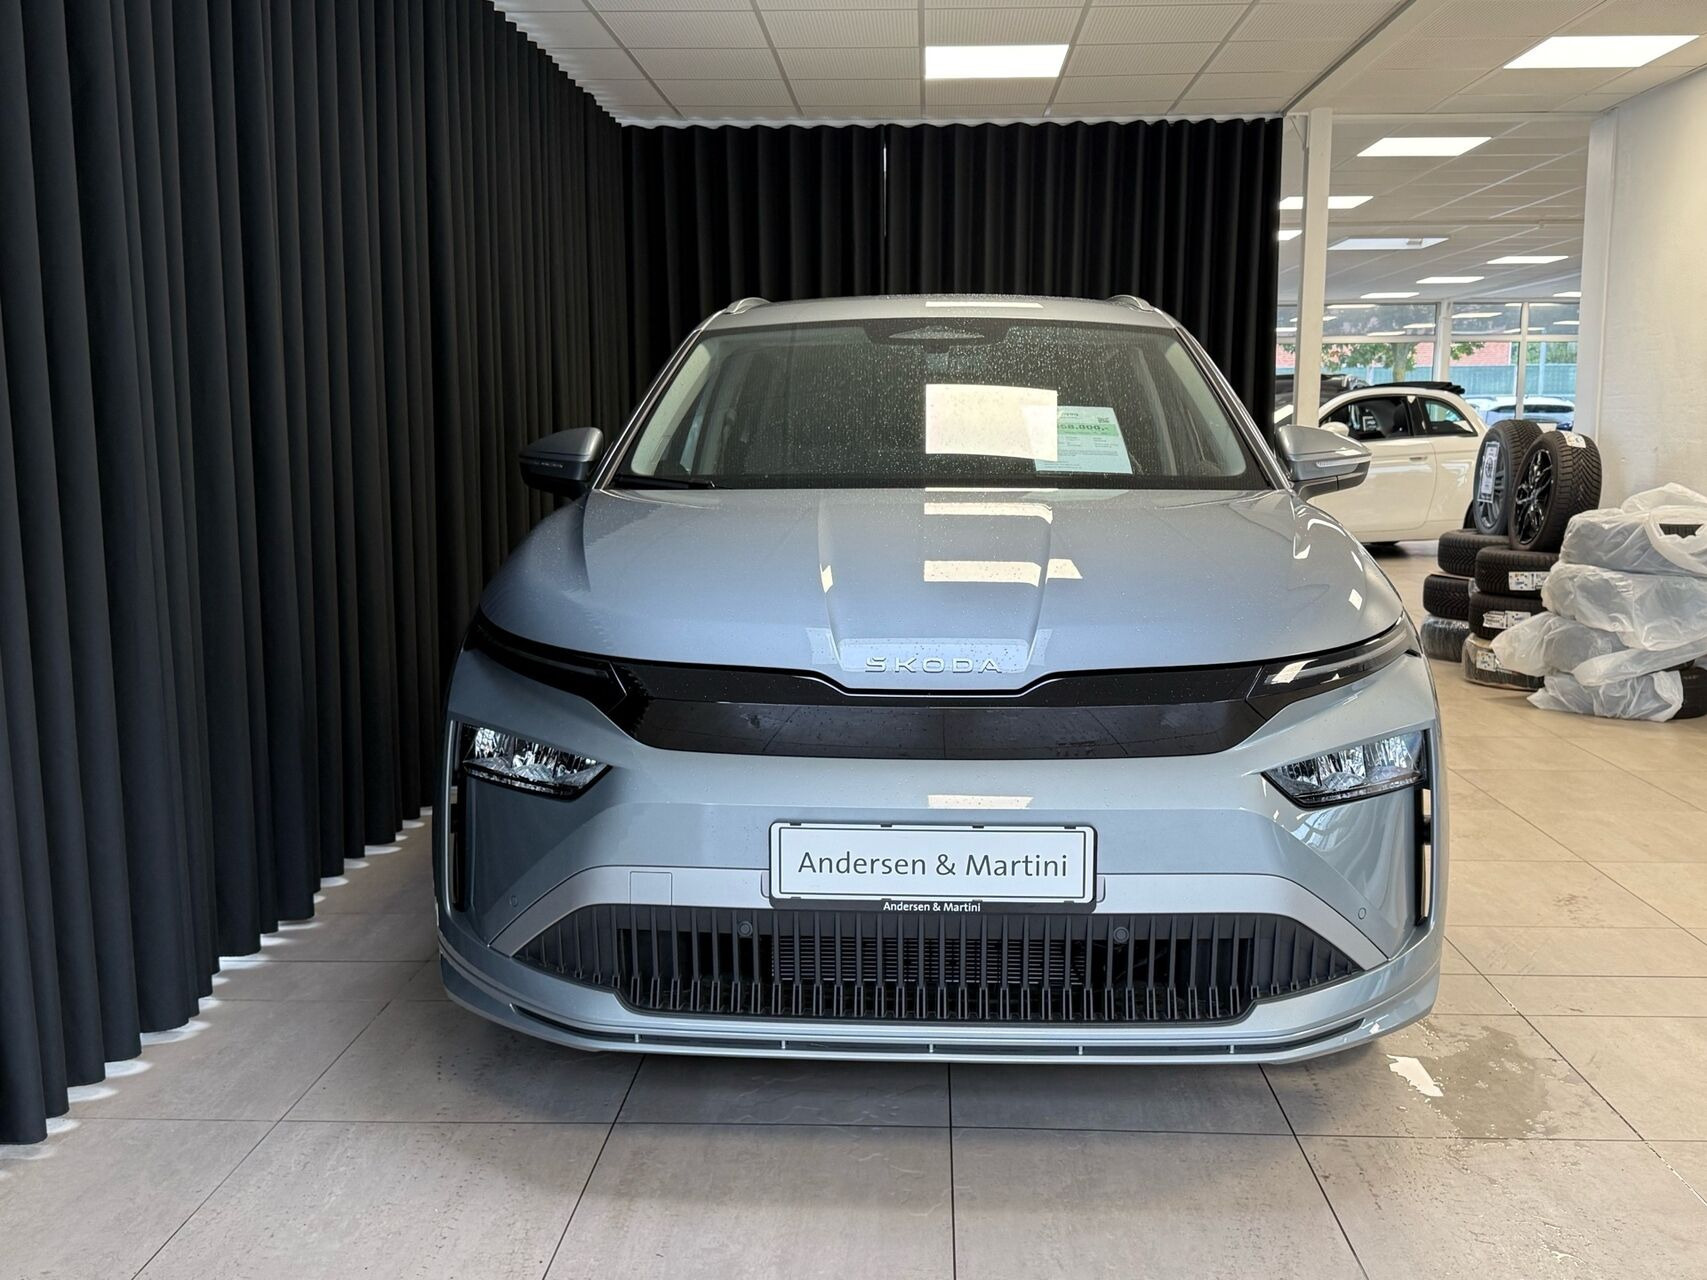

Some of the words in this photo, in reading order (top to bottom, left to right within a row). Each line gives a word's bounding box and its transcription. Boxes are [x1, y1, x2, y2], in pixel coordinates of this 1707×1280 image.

[797, 851, 926, 876] Andersen
[935, 854, 956, 876] &
[965, 854, 1068, 877] Martini
[883, 901, 930, 912] Andersen
[933, 902, 941, 912] &
[943, 902, 981, 913] Martini
